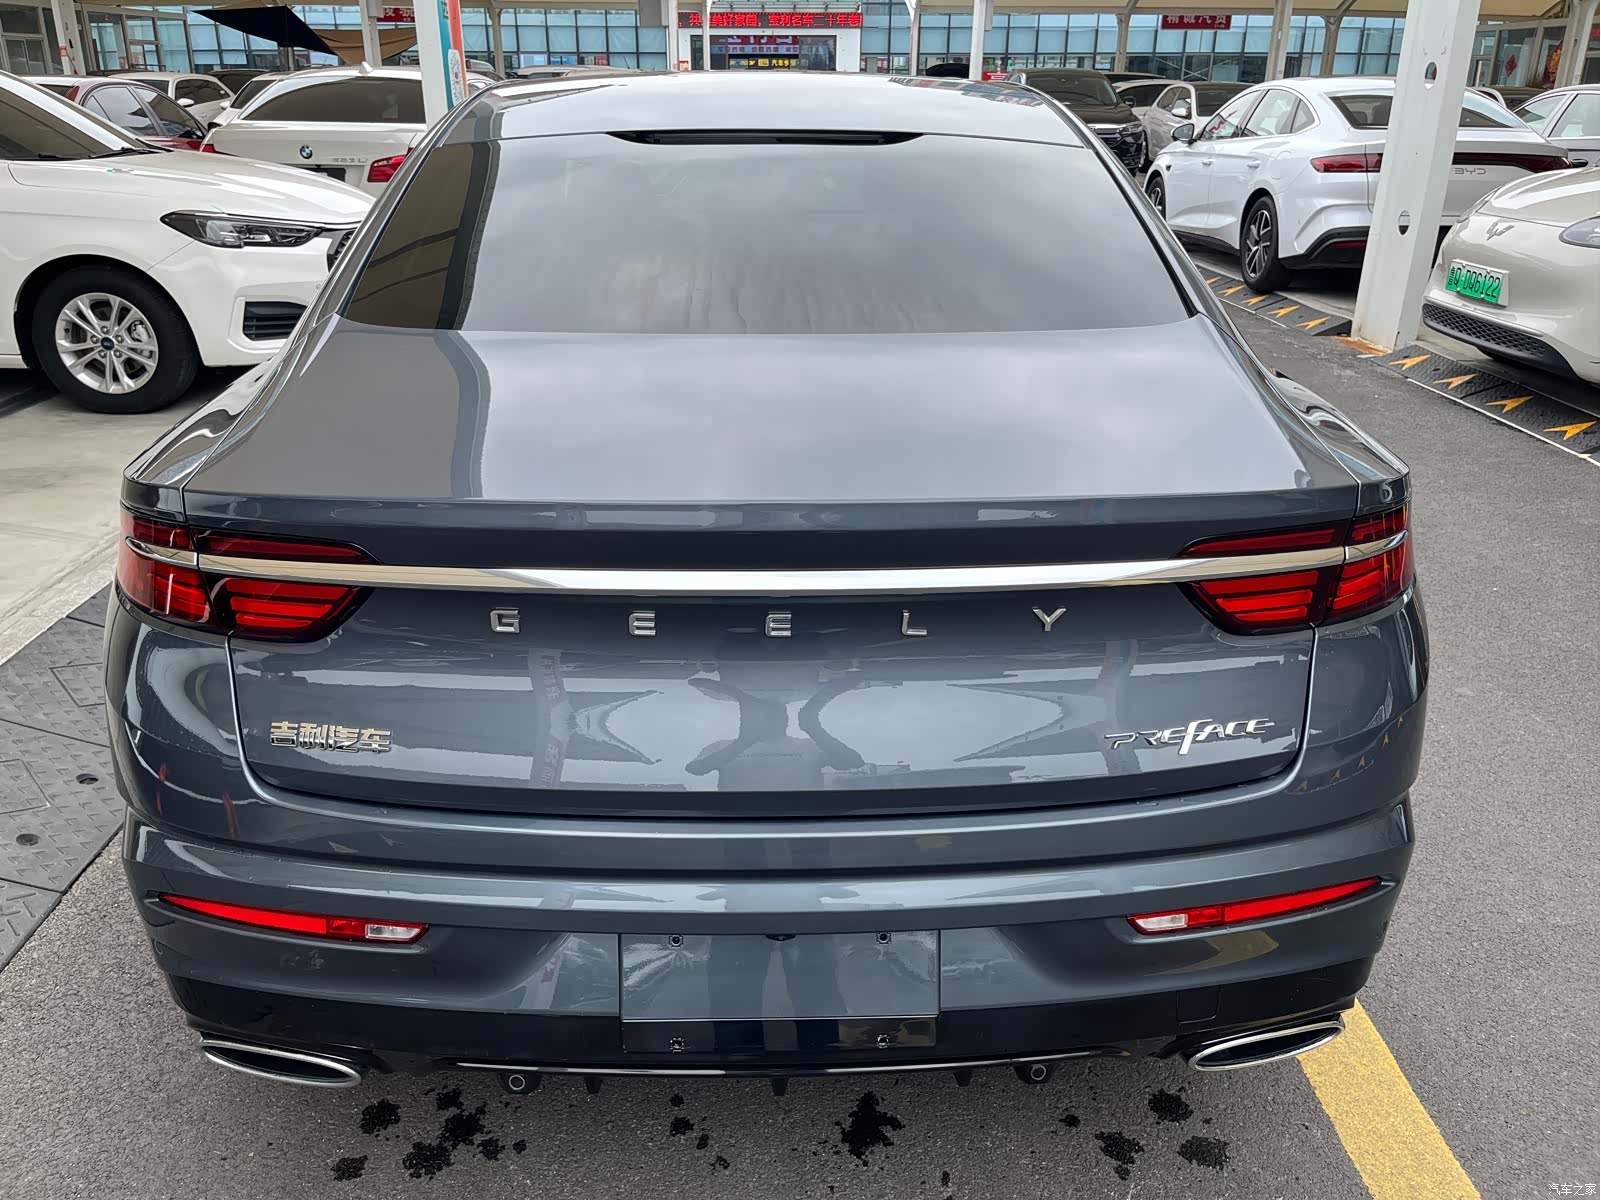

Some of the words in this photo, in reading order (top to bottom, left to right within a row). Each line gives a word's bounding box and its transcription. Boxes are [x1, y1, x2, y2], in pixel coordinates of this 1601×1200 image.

[1454, 167, 1487, 175] BYD
[490, 607, 1066, 637] GEELY
[270, 721, 391, 753] 吉利汽车
[1104, 718, 1275, 755] PREFACE
